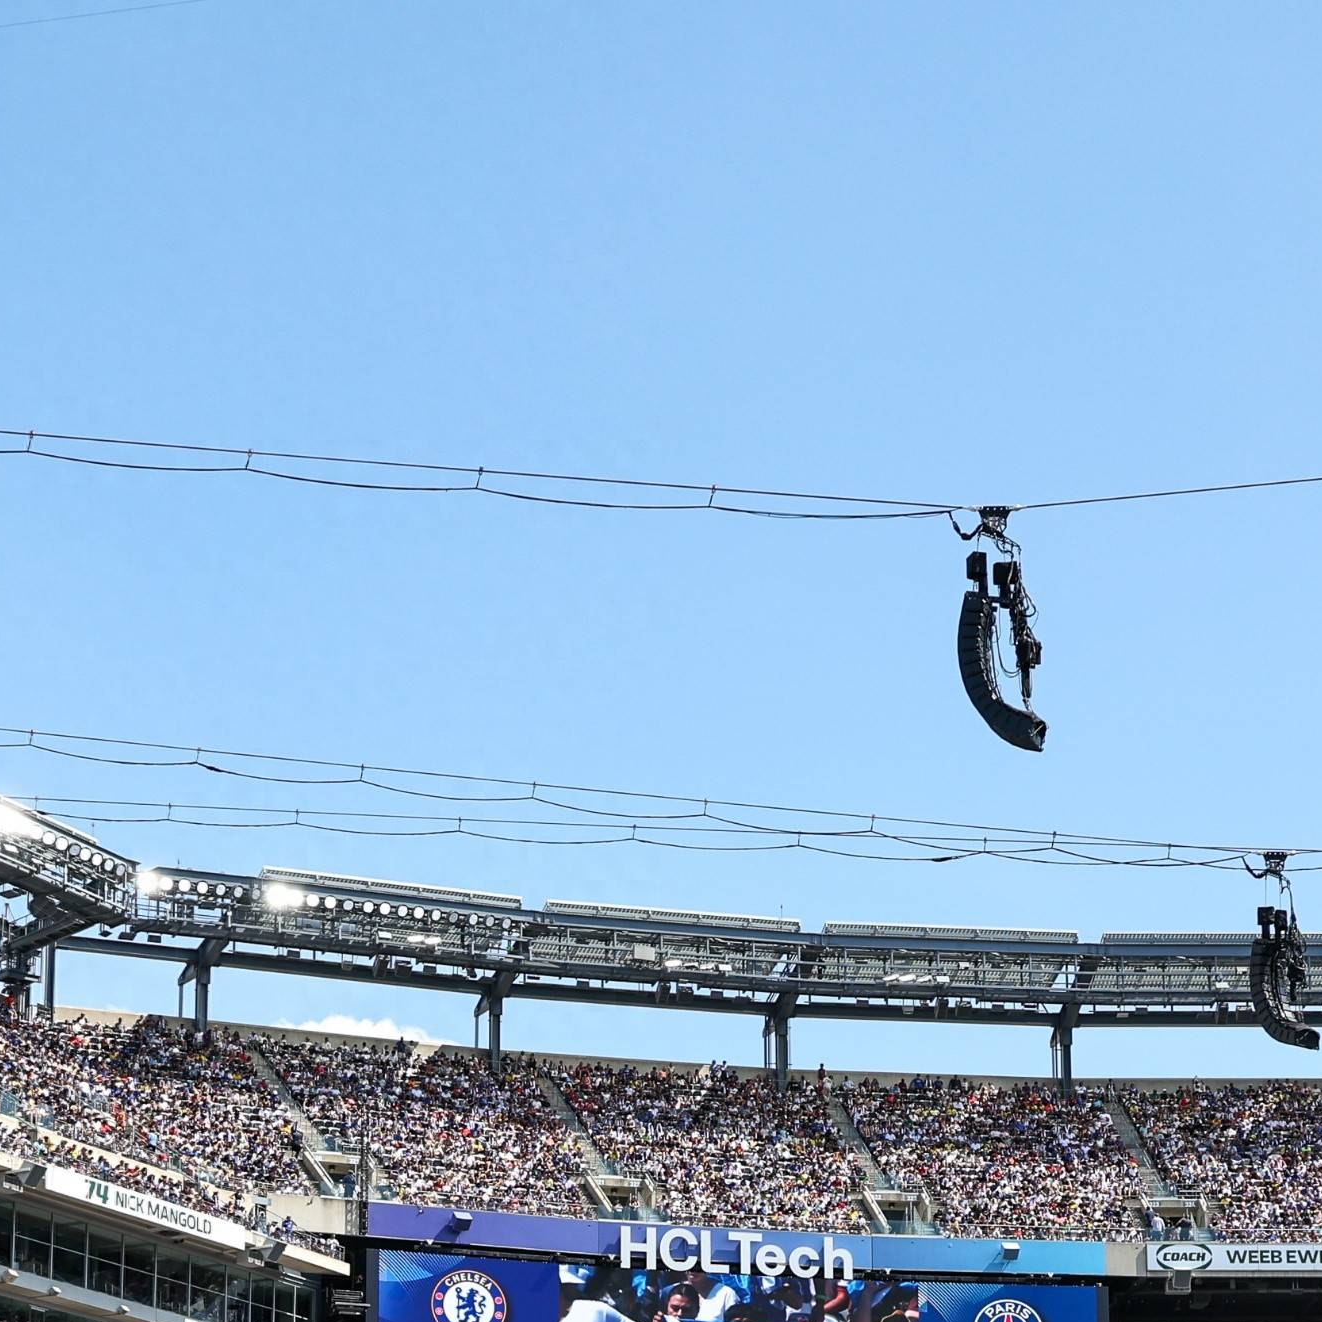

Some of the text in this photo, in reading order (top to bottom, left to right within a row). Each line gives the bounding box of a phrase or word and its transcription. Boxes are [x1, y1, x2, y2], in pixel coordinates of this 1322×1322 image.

[85, 1178, 109, 1204] 74
[116, 1191, 212, 1235] NICK MANGOLD
[620, 1225, 854, 1280] HCLTech
[1163, 1251, 1206, 1262] COACH
[1226, 1250, 1282, 1264] WEEB
[444, 1272, 493, 1290] CHELSEA
[984, 1302, 1032, 1319] PARIS
